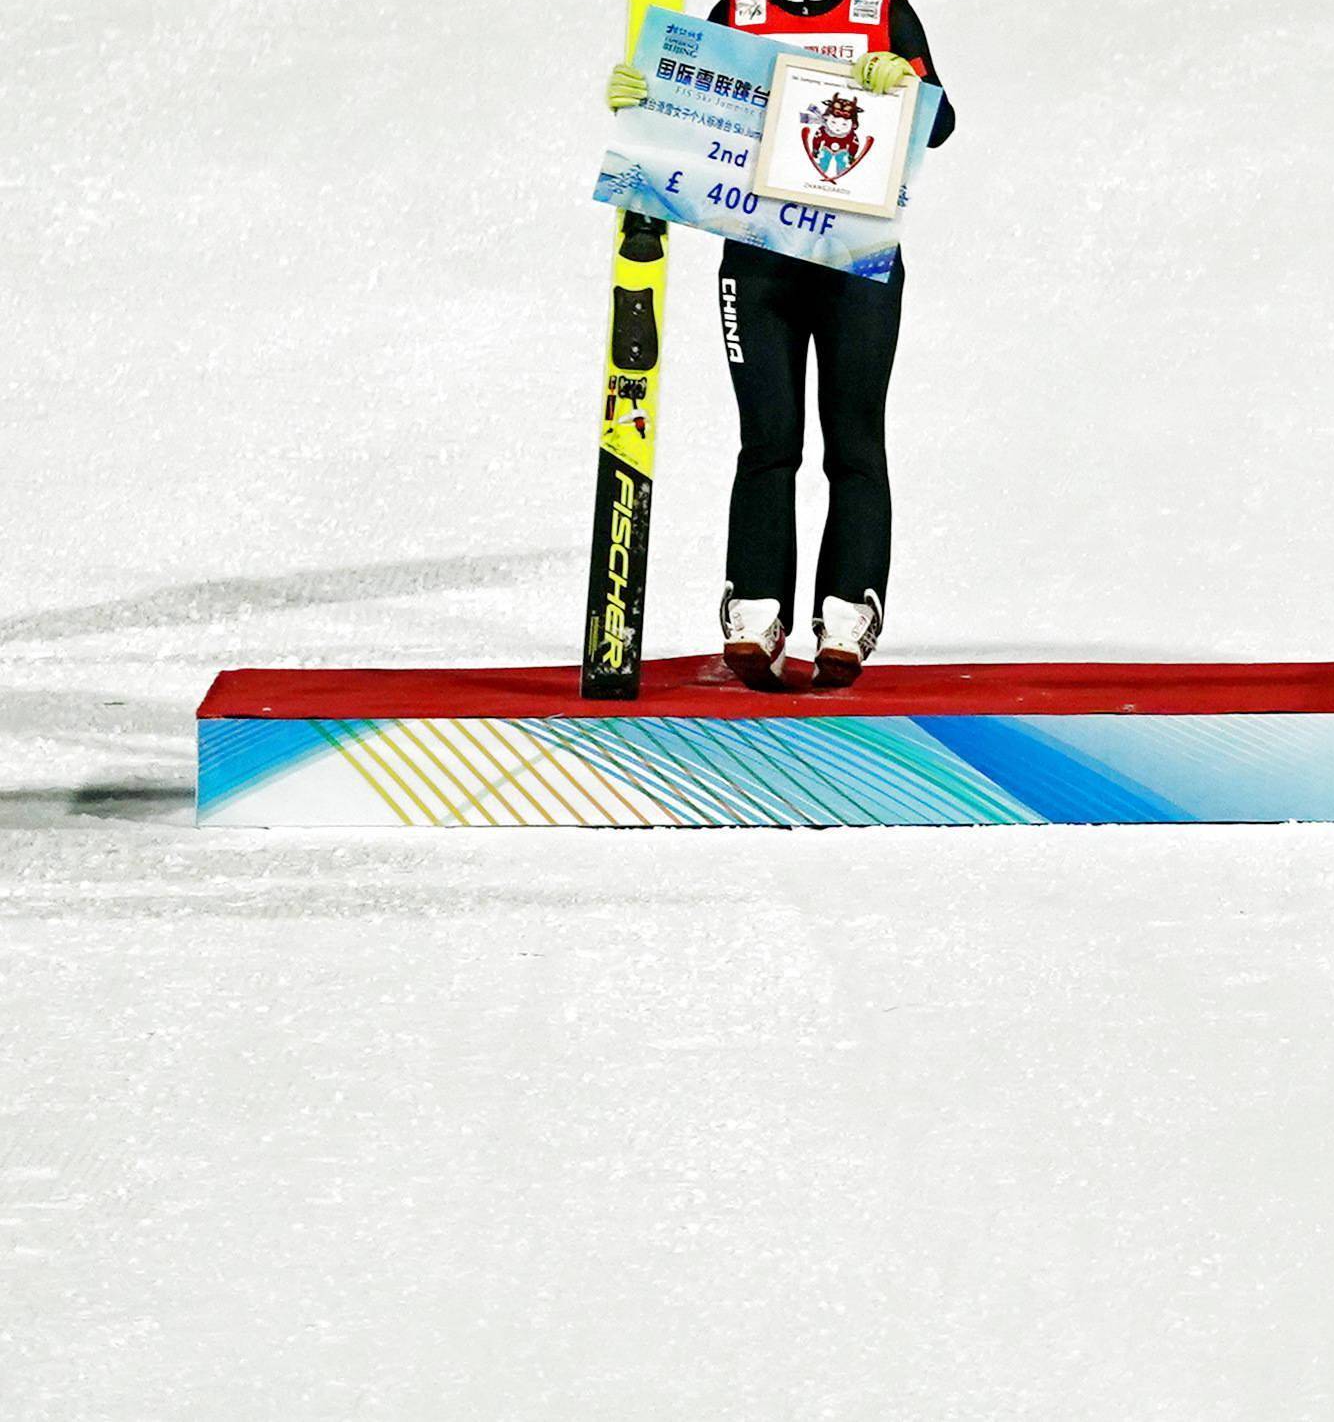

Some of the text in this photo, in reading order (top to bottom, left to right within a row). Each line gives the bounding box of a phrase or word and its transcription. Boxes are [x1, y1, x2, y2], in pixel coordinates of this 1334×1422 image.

[656, 57, 771, 108] 国际雪联跳台
[708, 141, 749, 168] 2nd
[665, 170, 837, 236] £ 400 CHF
[721, 278, 744, 364] CHINA
[602, 469, 634, 669] FISCHER
